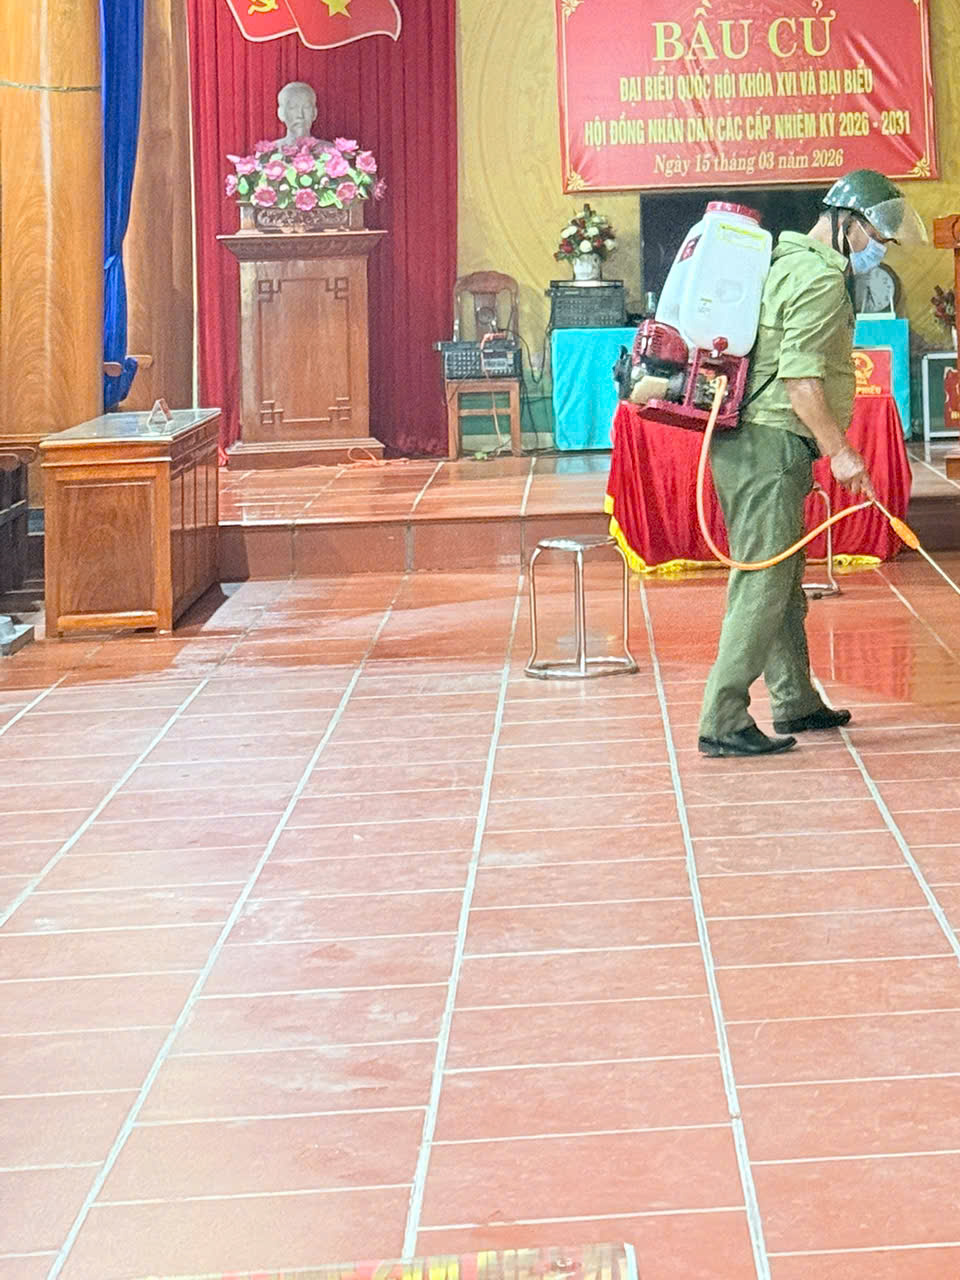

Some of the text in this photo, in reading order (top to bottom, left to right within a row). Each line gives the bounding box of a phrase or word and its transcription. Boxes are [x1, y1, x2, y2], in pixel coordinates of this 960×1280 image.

[768, 0, 837, 58] CỬ
[619, 59, 873, 107] ĐẠI BIỂU QUỐC HỘI KHÓA XVI VÀ ĐẠI BIỂU
[584, 115, 606, 151] HỘI
[648, 113, 684, 144] NHÂN
[687, 113, 714, 144] DÂN
[717, 111, 742, 141] CÁC
[745, 106, 771, 140] CẤP
[775, 108, 816, 144] NHIỆM
[839, 111, 870, 136] 2026
[881, 111, 911, 135] 2031
[653, 149, 844, 177] Ngày 15 tháng 03 năm 2026
